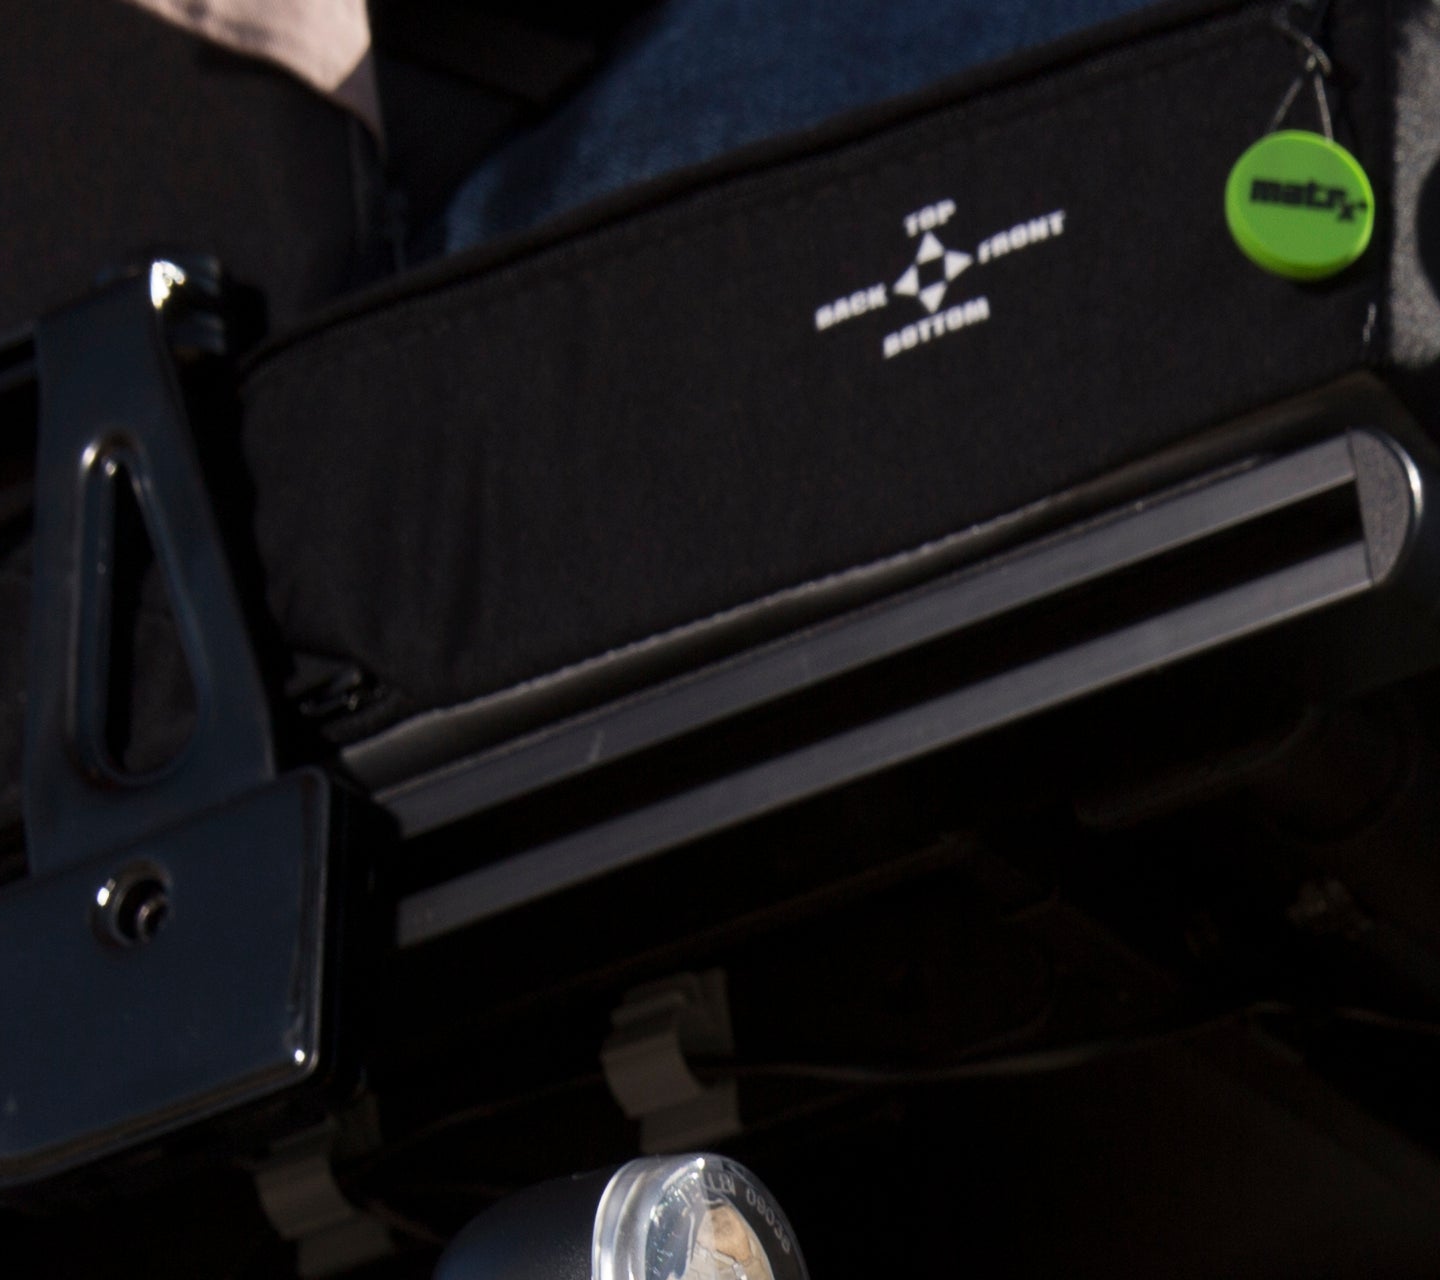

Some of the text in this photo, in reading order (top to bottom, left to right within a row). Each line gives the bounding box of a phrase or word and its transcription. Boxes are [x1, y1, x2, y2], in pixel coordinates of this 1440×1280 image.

[903, 198, 957, 238] TOP
[977, 209, 1066, 265] FRONT
[815, 282, 888, 332] BACK
[883, 295, 990, 360] BOTTOM
